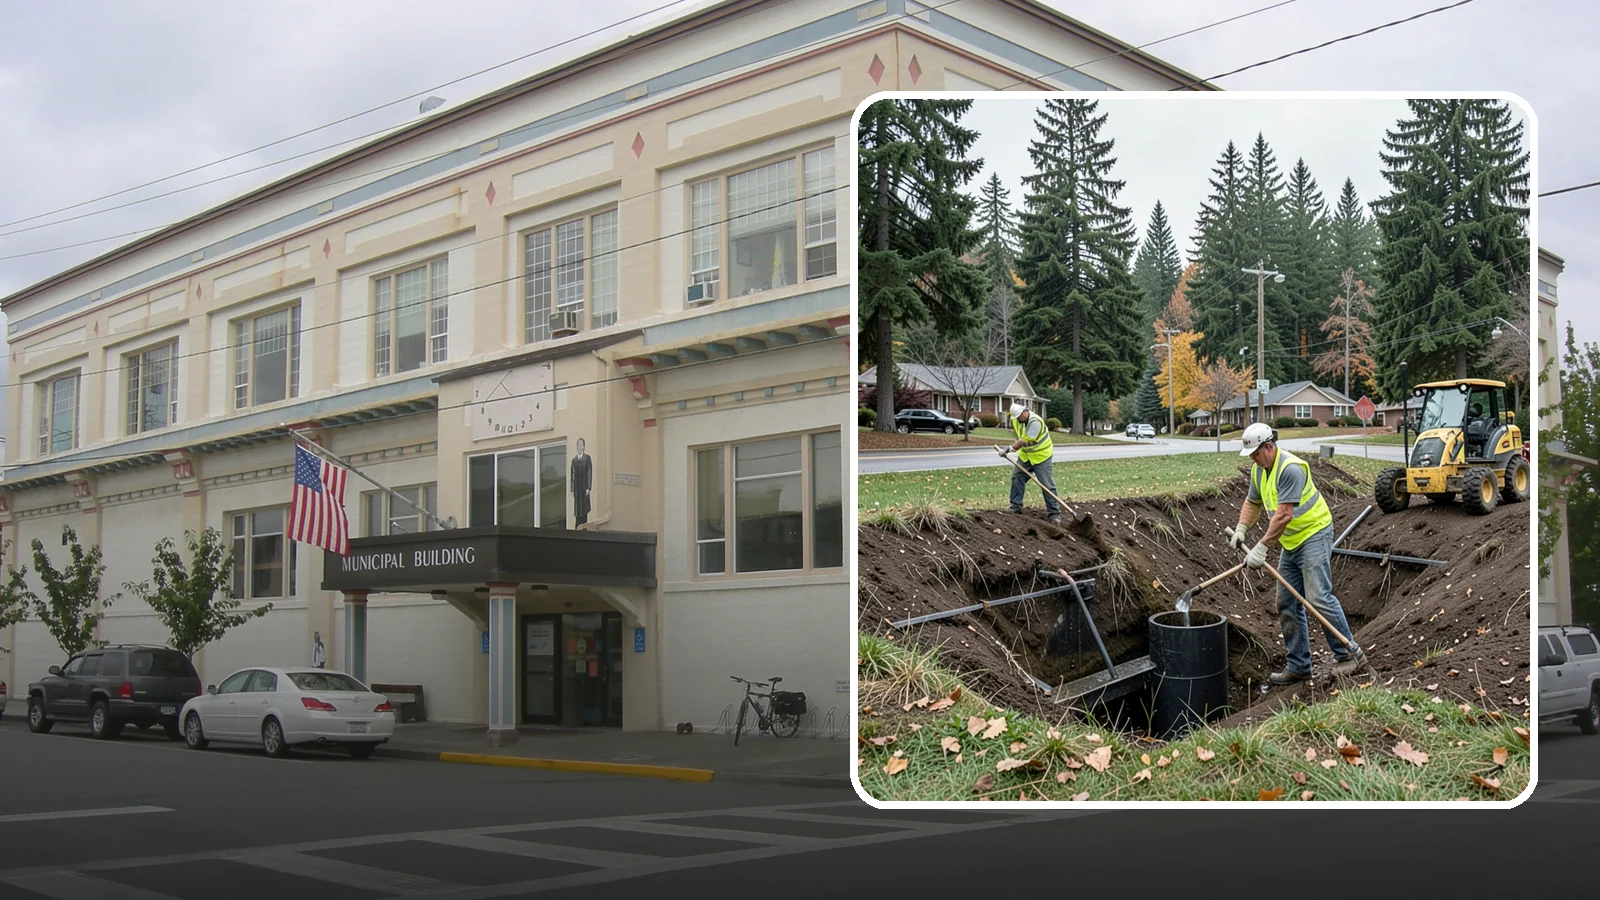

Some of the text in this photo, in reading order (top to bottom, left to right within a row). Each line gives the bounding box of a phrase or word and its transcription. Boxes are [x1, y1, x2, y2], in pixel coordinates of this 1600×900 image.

[494, 424, 500, 432] 10
[501, 425, 506, 434] 11
[507, 425, 513, 433] 12
[342, 546, 475, 572] MUNICIPAL BUILDING
